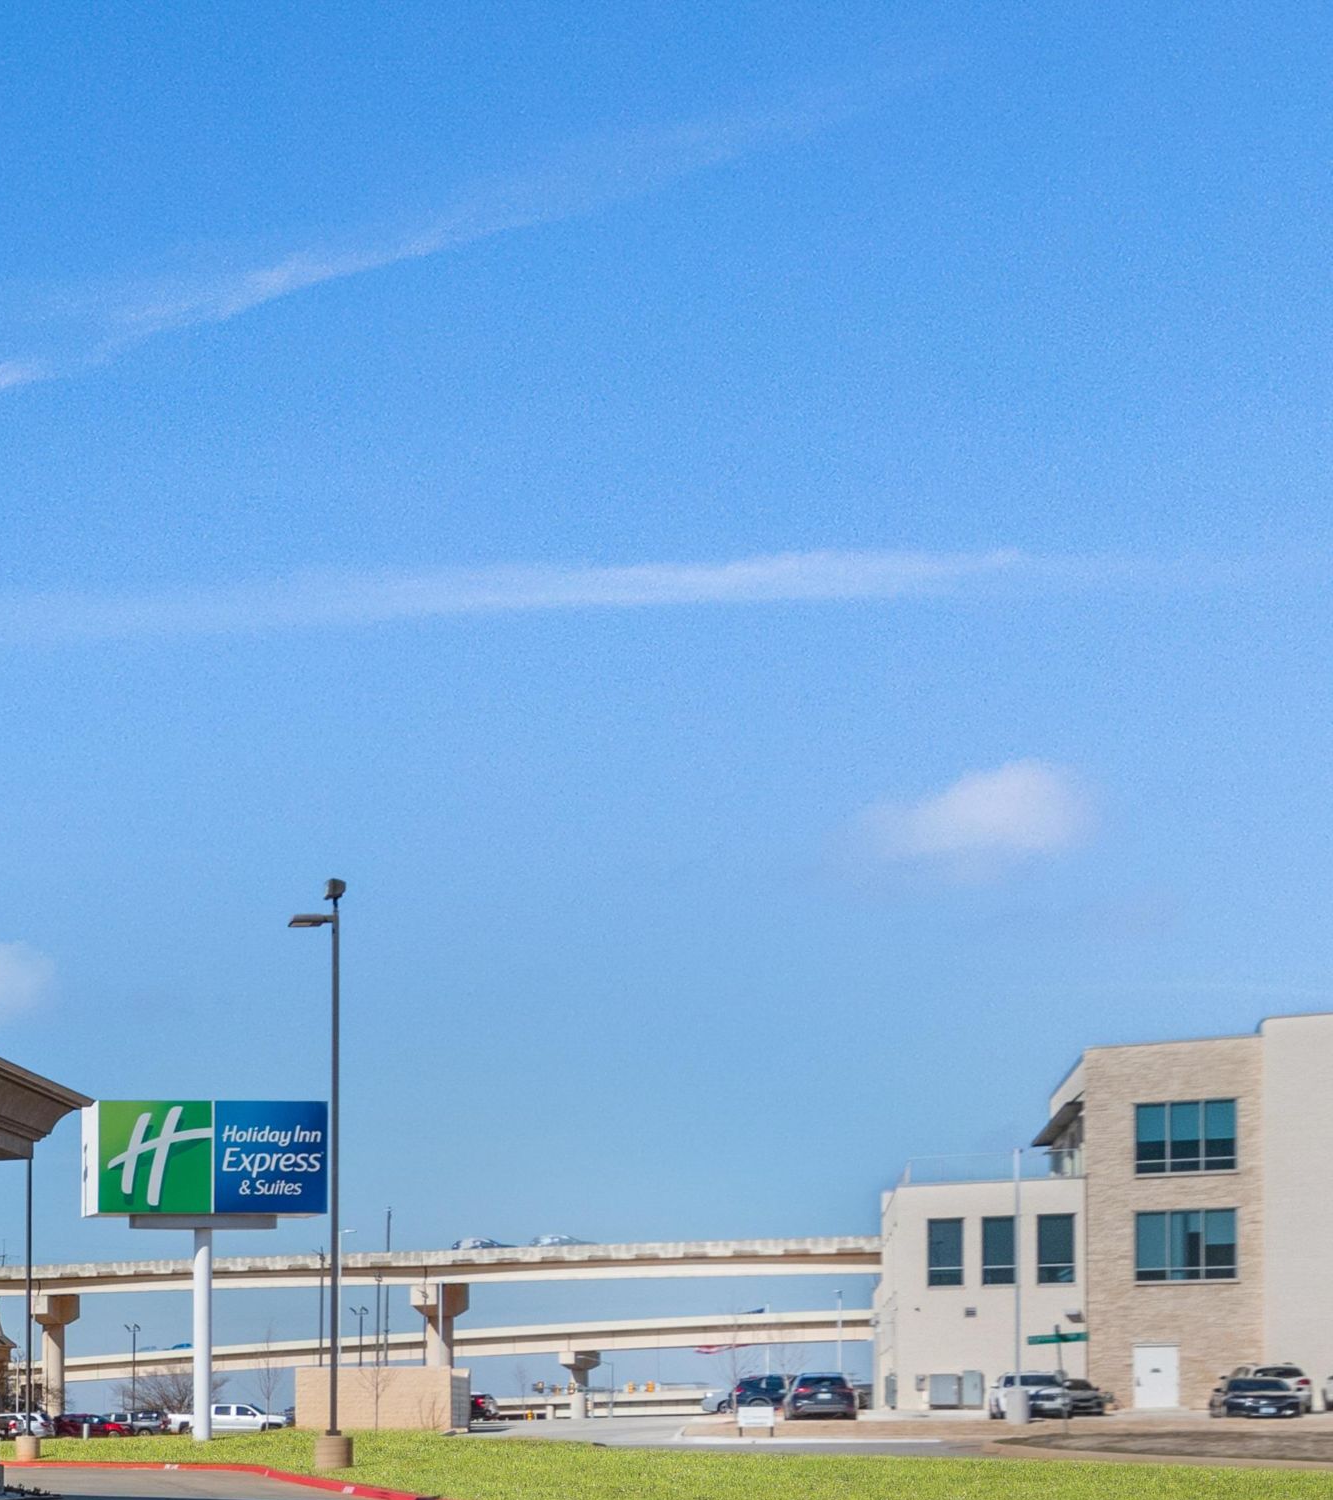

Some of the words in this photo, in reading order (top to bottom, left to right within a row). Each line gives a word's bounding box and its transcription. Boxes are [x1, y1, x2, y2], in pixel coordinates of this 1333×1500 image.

[222, 1124, 292, 1147] Holiday
[293, 1124, 322, 1143] Inn
[222, 1147, 322, 1178] Express
[238, 1179, 251, 1195] &
[253, 1179, 303, 1196] Suites
